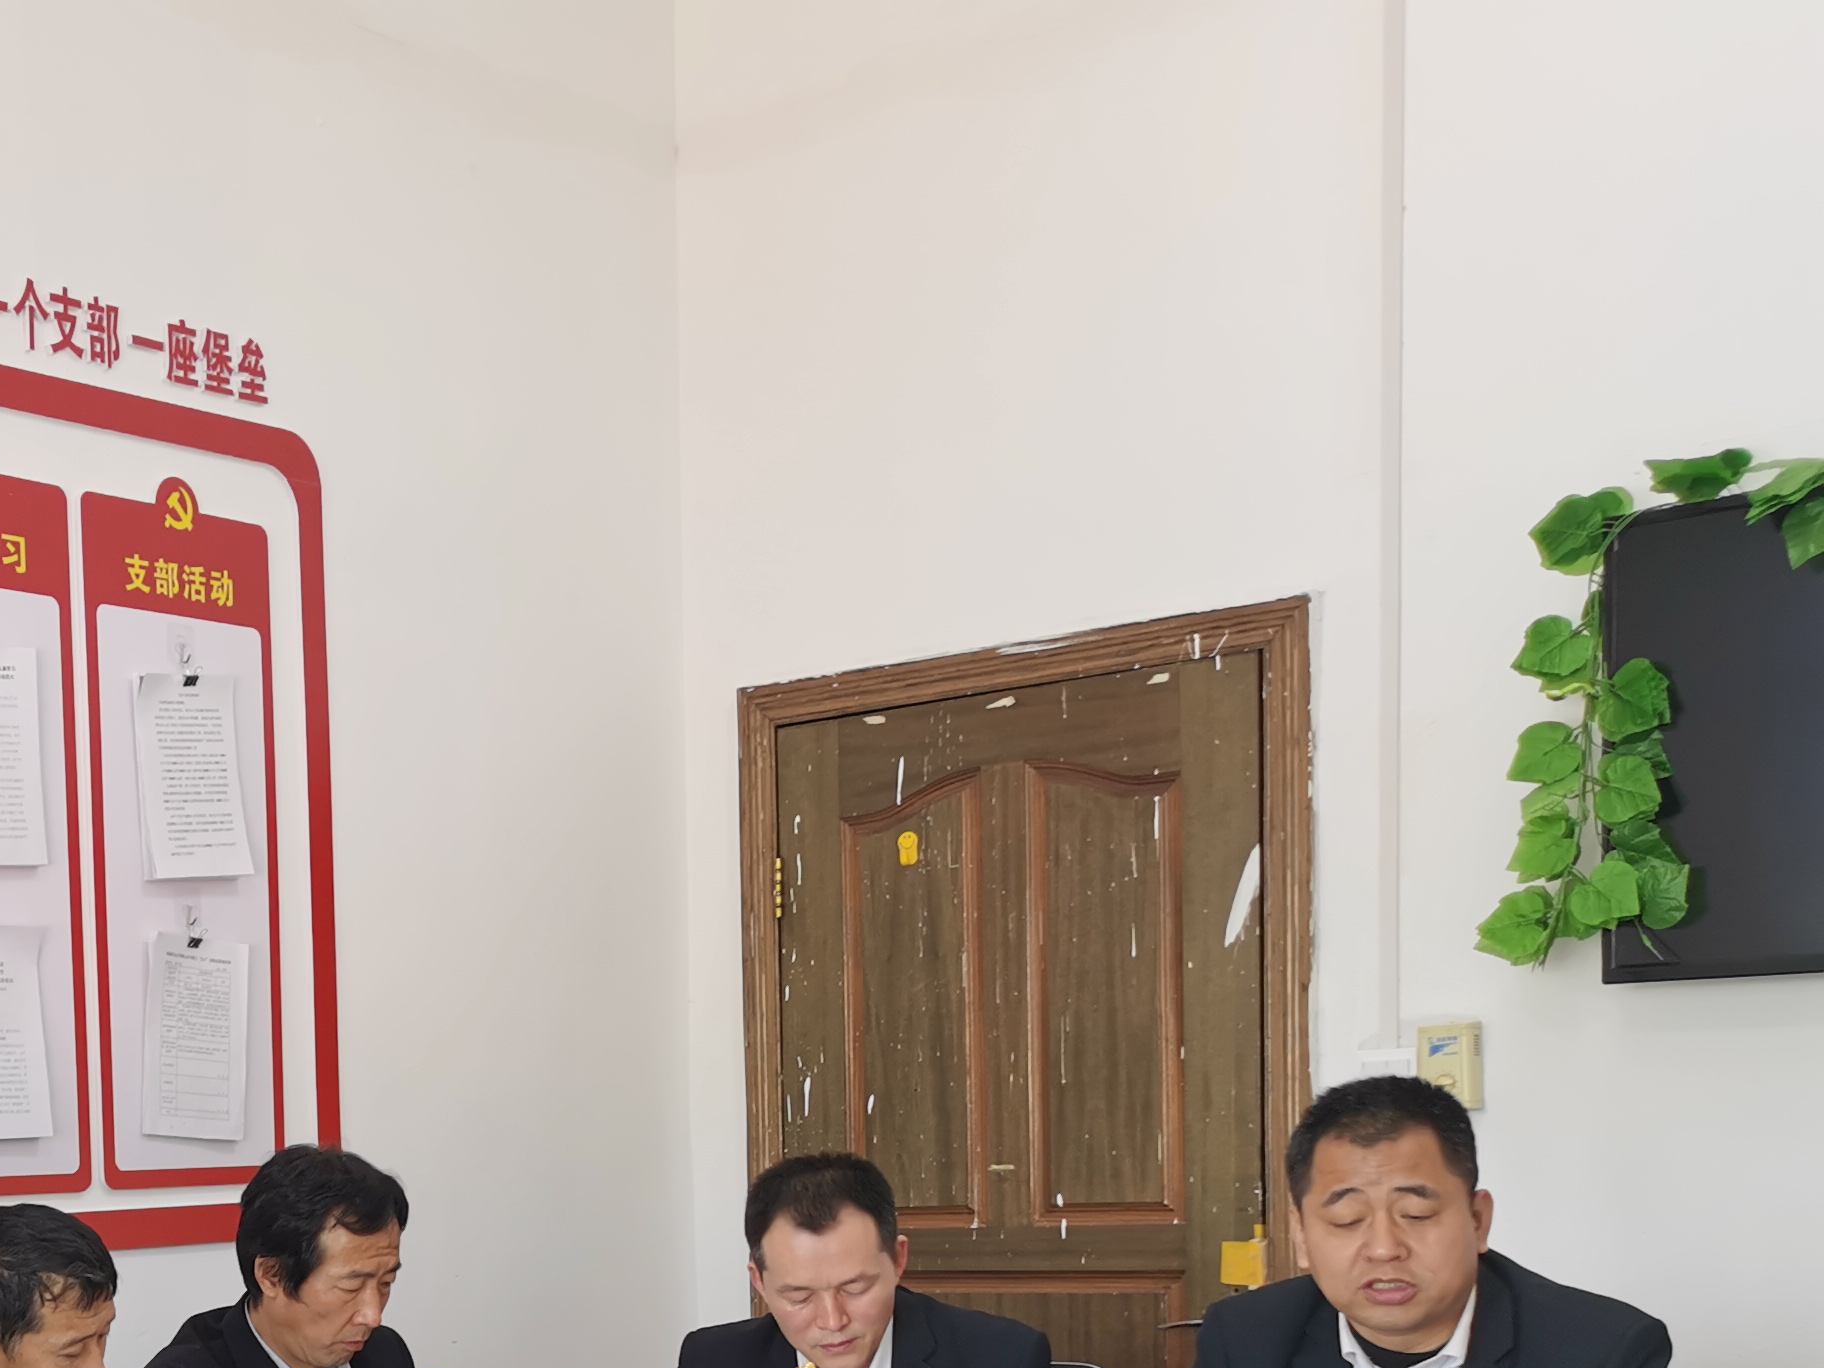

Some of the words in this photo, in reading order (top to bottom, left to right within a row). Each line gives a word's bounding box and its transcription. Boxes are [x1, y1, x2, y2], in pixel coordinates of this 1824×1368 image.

[131, 320, 269, 405] 一座堡垒
[124, 554, 234, 607] 支部活动
